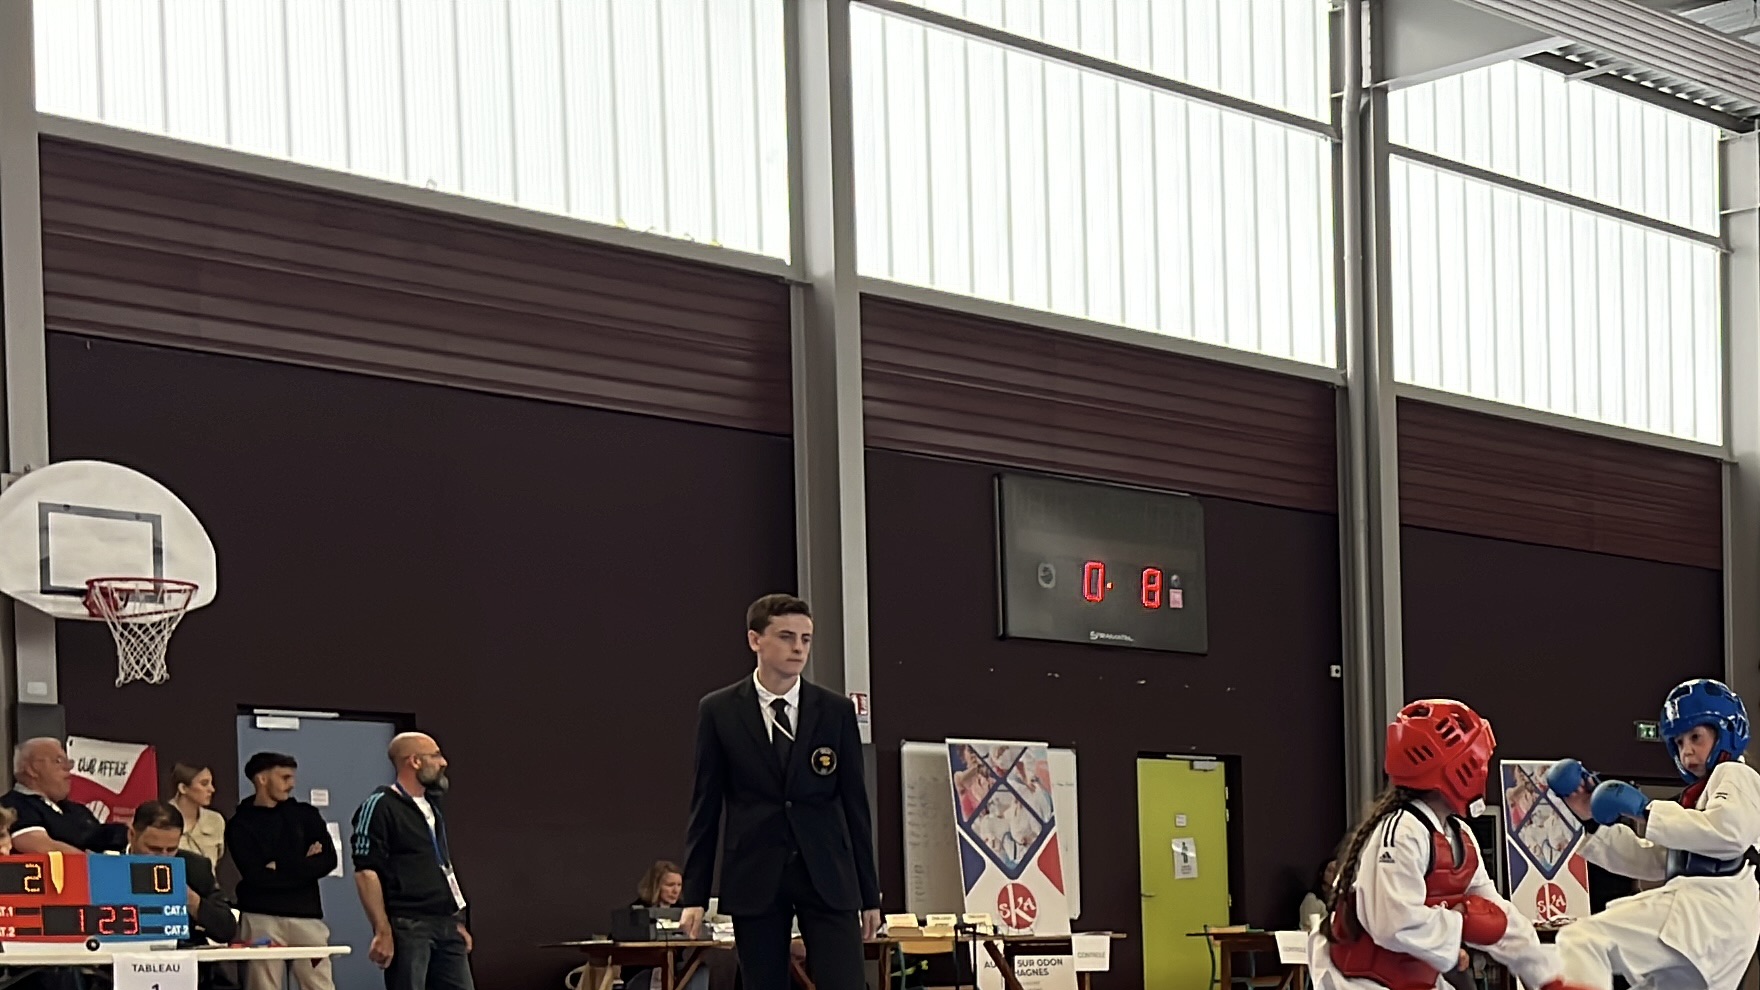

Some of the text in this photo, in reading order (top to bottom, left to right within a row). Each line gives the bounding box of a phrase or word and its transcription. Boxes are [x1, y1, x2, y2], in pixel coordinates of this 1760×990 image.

[1142, 567, 1163, 609] 8
[24, 863, 42, 893] 2
[153, 864, 171, 893] 0
[0, 906, 14, 917] T.1
[0, 926, 16, 937] T.2
[132, 963, 181, 973] TABLEAU
[1017, 958, 1063, 968] SUR ODON
